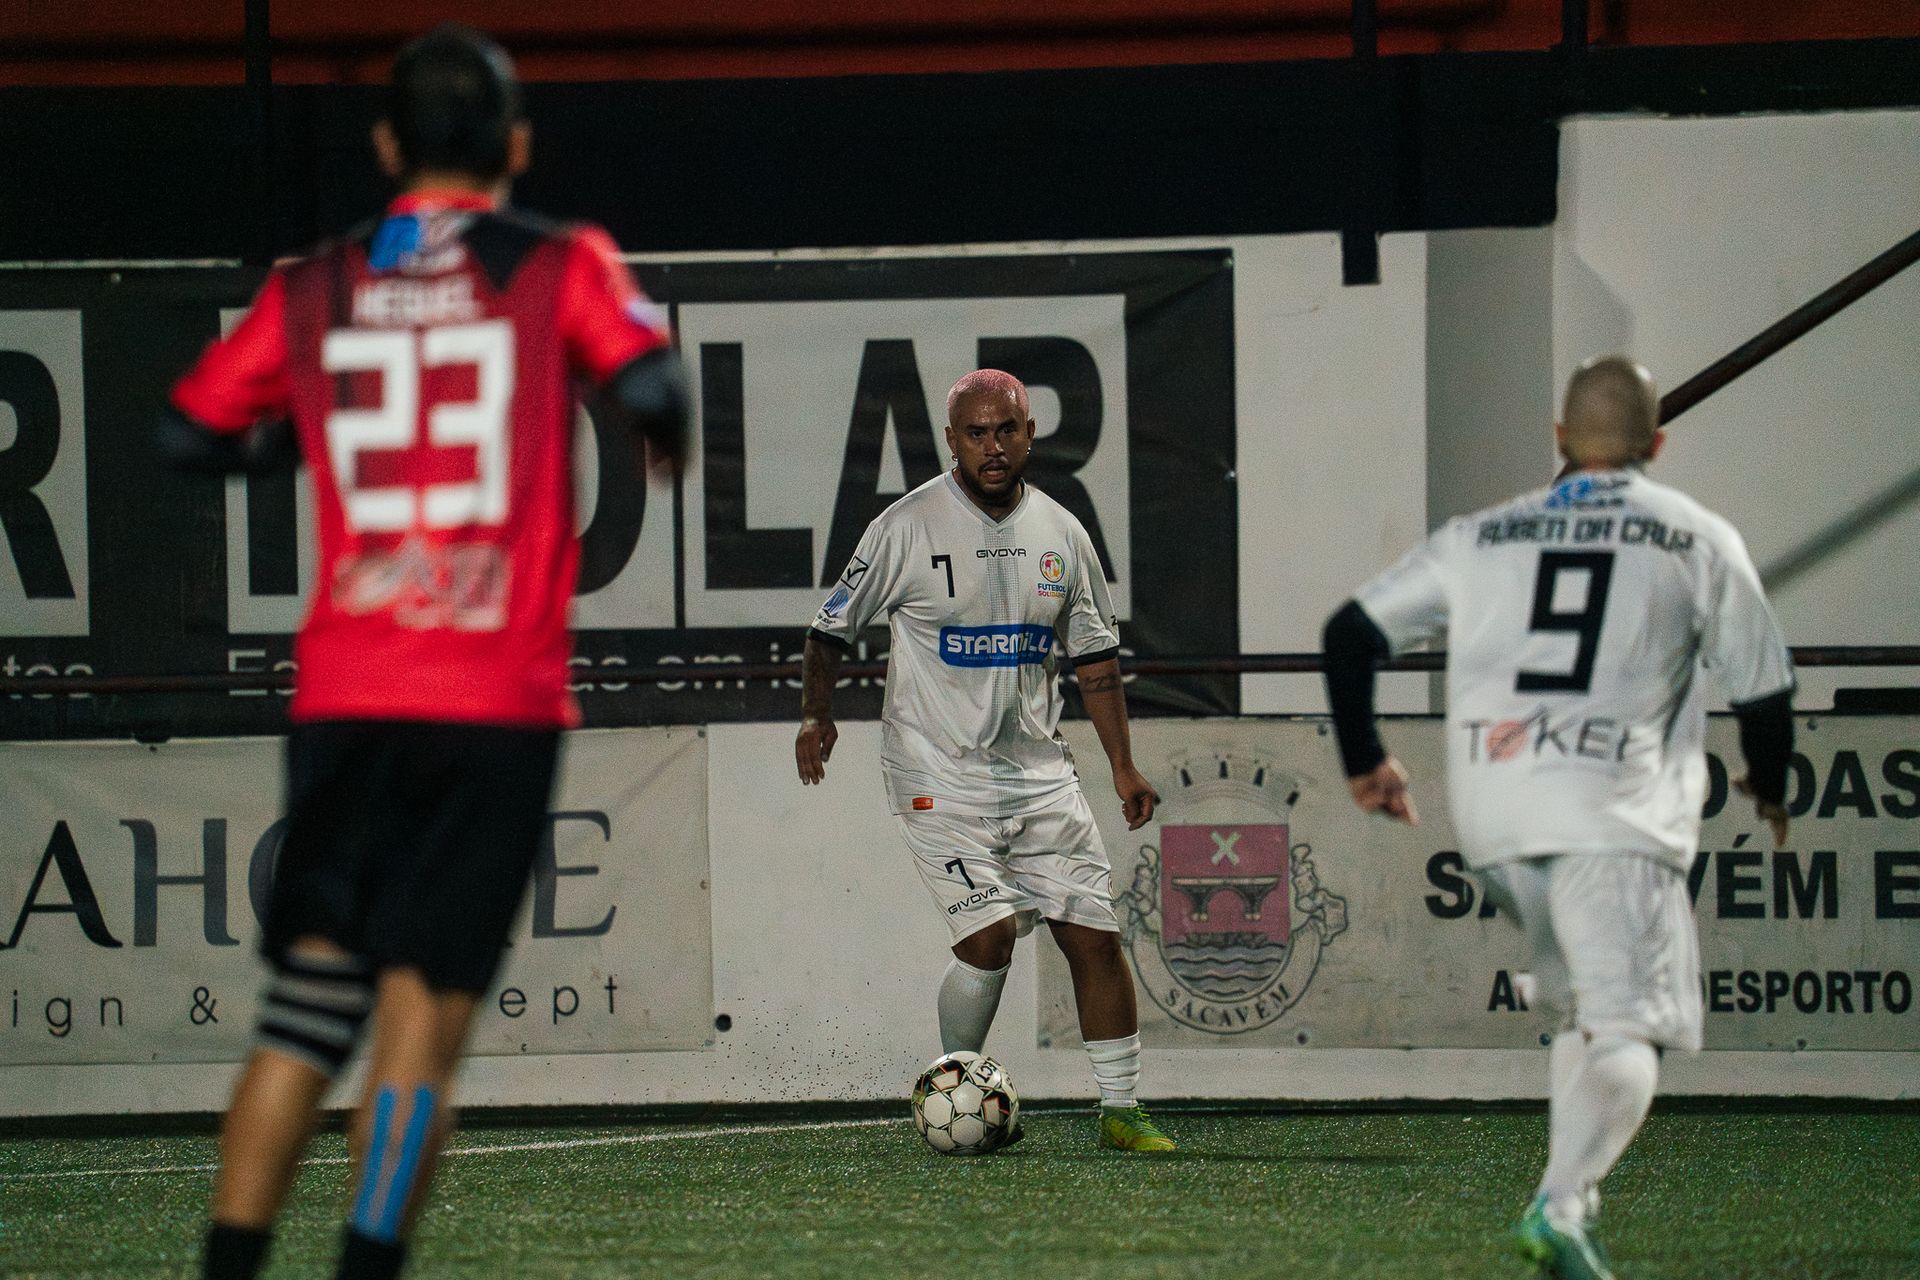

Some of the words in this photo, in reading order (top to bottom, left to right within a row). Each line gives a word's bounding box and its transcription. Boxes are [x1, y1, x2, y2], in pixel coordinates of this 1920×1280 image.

[322, 320, 516, 533] 23
[975, 547, 1027, 559] GIVOVA
[930, 554, 955, 598] 7
[1037, 582, 1067, 593] FUTEBOL
[1515, 551, 1616, 694] 9
[944, 858, 975, 890] 7
[948, 886, 999, 914] GIVOVA
[190, 986, 219, 1025] &
[1700, 970, 1913, 1014] ESPORTO
